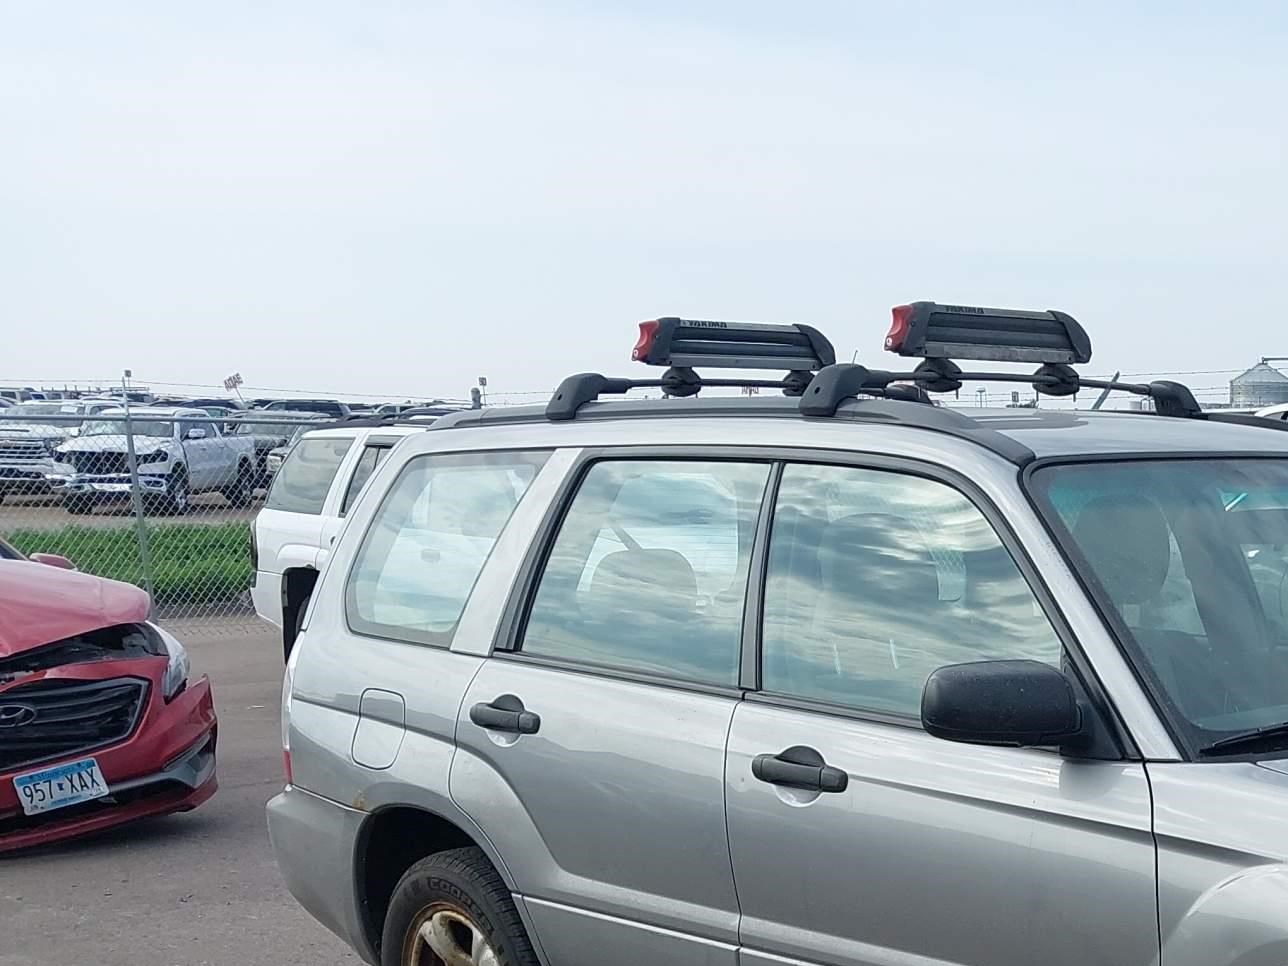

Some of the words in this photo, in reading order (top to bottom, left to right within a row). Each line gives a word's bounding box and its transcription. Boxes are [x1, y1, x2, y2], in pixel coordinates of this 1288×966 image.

[689, 320, 728, 328] YAKIMA
[22, 780, 54, 804] 957
[65, 768, 100, 794] XAX
